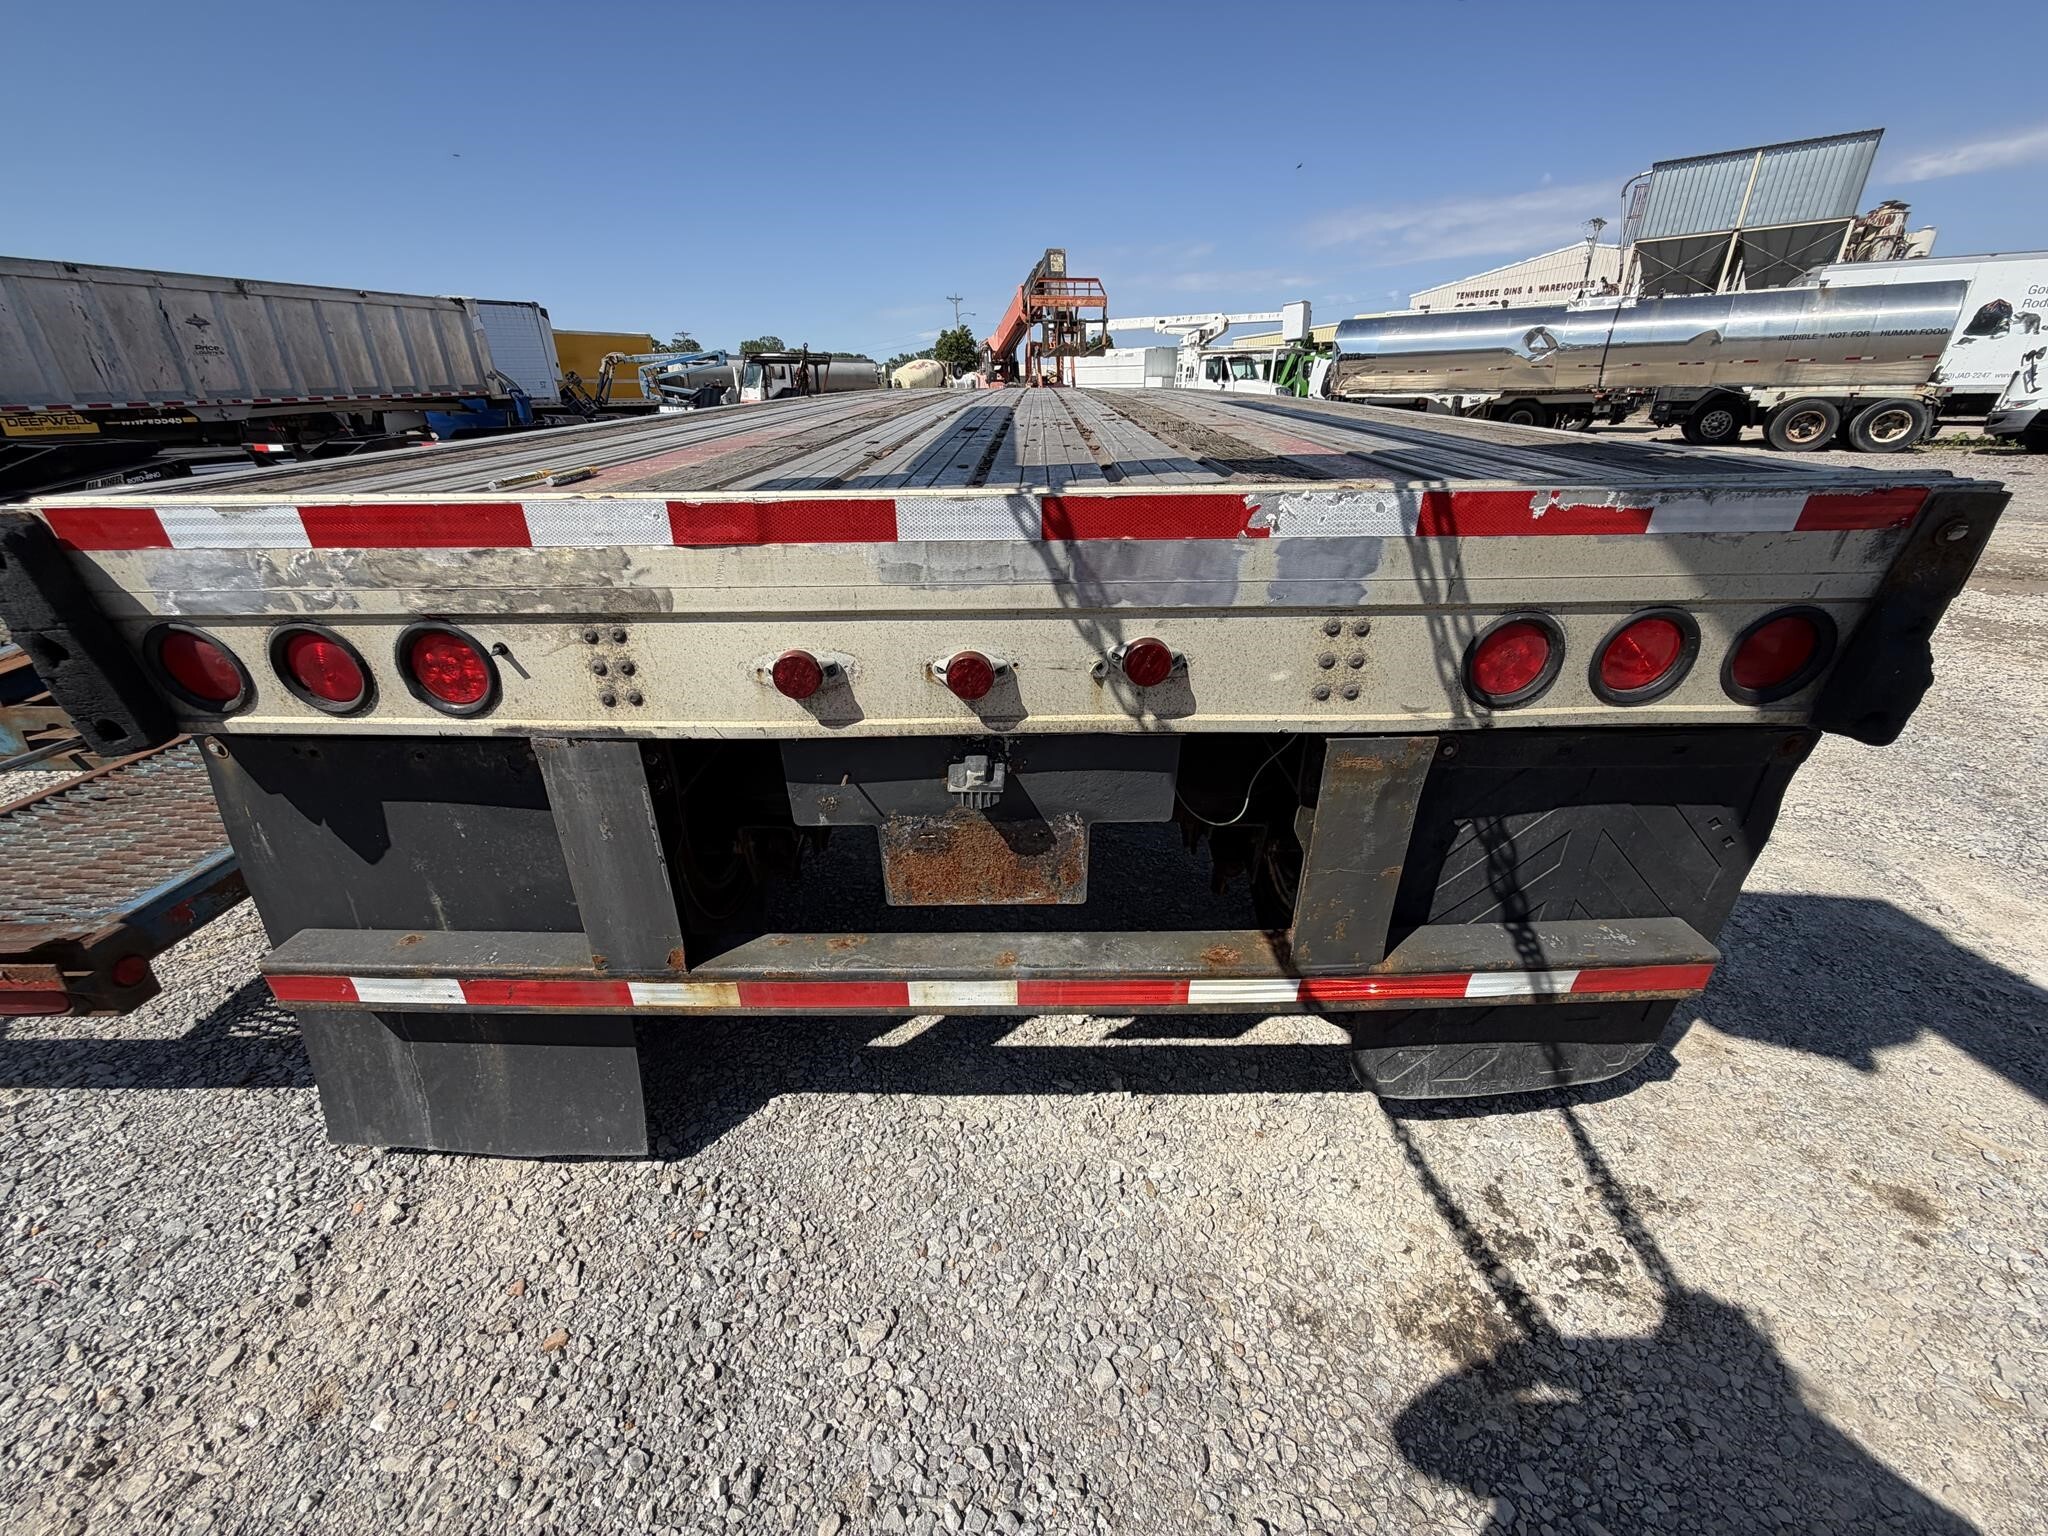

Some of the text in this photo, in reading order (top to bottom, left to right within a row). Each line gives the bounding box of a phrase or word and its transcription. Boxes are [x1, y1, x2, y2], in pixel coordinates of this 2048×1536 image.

[1456, 288, 1499, 300] TENNESSEE
[1528, 285, 1533, 294] &
[1539, 279, 1596, 293] WAREHOUSES
[1778, 332, 1818, 341] INEDIBLE
[1828, 331, 1848, 339] NOT
[1851, 330, 1870, 338] FOR
[1880, 329, 1916, 337] HUMAN
[1919, 327, 1949, 336] FOOD
[5, 414, 93, 428] DEEPWELL
